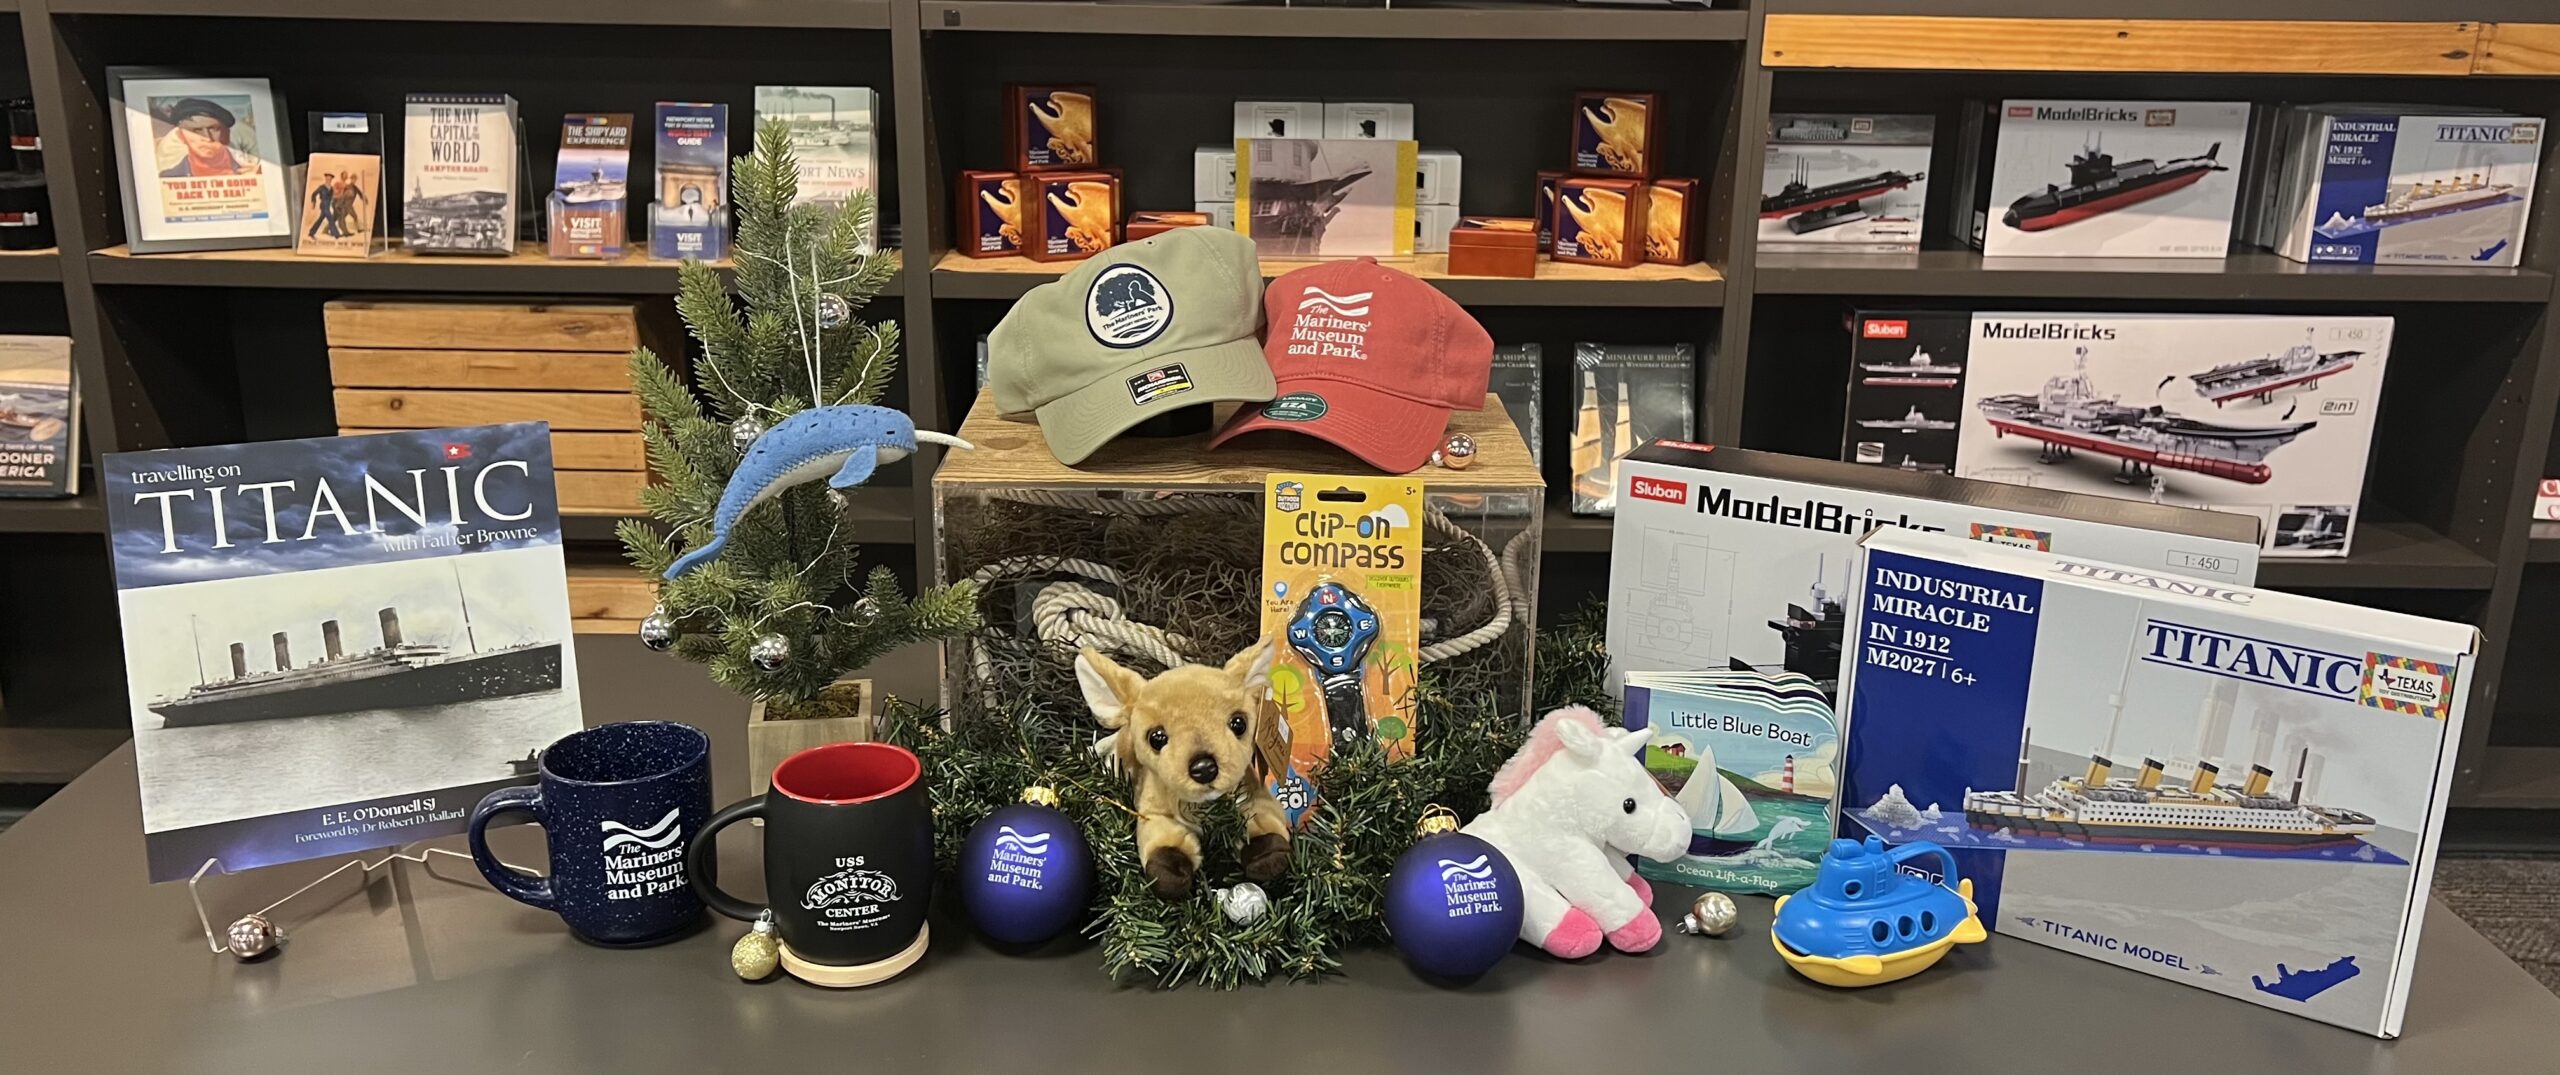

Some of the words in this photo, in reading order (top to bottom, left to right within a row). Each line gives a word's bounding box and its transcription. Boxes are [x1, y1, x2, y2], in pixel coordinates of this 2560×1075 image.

[431, 107, 451, 124] THE
[454, 107, 480, 124] NAVY
[2037, 106, 2137, 122] ModelBricks
[430, 125, 472, 140] CAPITAL
[568, 126, 583, 136] THE
[585, 126, 627, 137] SHIPYARD
[2333, 122, 2396, 132] INDUSTRIAL
[2437, 125, 2511, 142] TITANIC
[566, 137, 625, 145] EXPERIENCE
[2331, 133, 2379, 143] MIRACLE
[431, 141, 480, 163] WORLD
[2330, 145, 2341, 154] IN
[571, 217, 602, 228] VISIT
[1115, 309, 1145, 325] Mariners'
[1147, 305, 1163, 313] Park
[1310, 305, 1329, 314] The
[1294, 313, 1372, 333] Mariners'
[1867, 323, 1904, 335] Sluban
[1983, 322, 2116, 340] ModelBricks
[1290, 327, 1364, 346] Museum
[1288, 342, 1319, 355] and
[131, 464, 215, 484] travelling
[217, 465, 241, 478] on
[1405, 487, 1417, 496] 5+
[1635, 480, 1683, 500] Sluban
[134, 460, 533, 555] TITANIC
[383, 536, 417, 553] with
[422, 531, 474, 549] Father
[477, 527, 538, 544] Browne
[2184, 555, 2221, 571] 1:450
[1875, 567, 2034, 615] INDUSTRIAL
[2055, 561, 2255, 604] TITANIC
[1322, 593, 1334, 604] N
[1270, 605, 1290, 613] Here!
[1872, 593, 1991, 633] MIRACLE
[1294, 629, 1306, 639] W
[1869, 621, 1898, 643] IN
[1903, 630, 1951, 654] 1912
[1333, 657, 1343, 666] S
[1866, 647, 1937, 677] M2027
[1951, 668, 1977, 686] 6+
[2147, 624, 2361, 695] TITANIC
[2397, 676, 2434, 693] TEXAS
[1671, 711, 1718, 730] Little
[1723, 716, 1763, 737] Blue
[1767, 723, 1812, 747] Boat
[322, 814, 336, 826] E.
[337, 811, 351, 824] E.
[353, 799, 421, 821] O'Donnell
[423, 798, 436, 811] SJ
[295, 826, 346, 844] Foreword
[348, 822, 360, 836] by
[362, 823, 377, 833] Dr
[378, 815, 414, 830] Robert
[416, 815, 428, 825] D.
[429, 808, 465, 822] Ballard
[604, 841, 685, 870] Mariners'
[619, 843, 641, 855] The
[1005, 842, 1020, 852] The
[835, 856, 865, 868] USS
[992, 848, 1047, 868] Mariners'
[605, 861, 684, 885] Museum
[990, 860, 1042, 878] Museum
[1453, 873, 1468, 882] The
[1676, 864, 1714, 879] Ocean
[1715, 870, 1778, 889] Lift-a-Flap
[988, 873, 1010, 884] and
[1444, 877, 1497, 895] Mariners'
[608, 884, 642, 900] and
[810, 875, 892, 905] MONITOR
[1446, 891, 1499, 906] Museum
[825, 904, 880, 918] CENTER
[1449, 904, 1472, 918] and
[2042, 920, 2118, 952] TITANIC
[2123, 942, 2191, 972] MODEL
